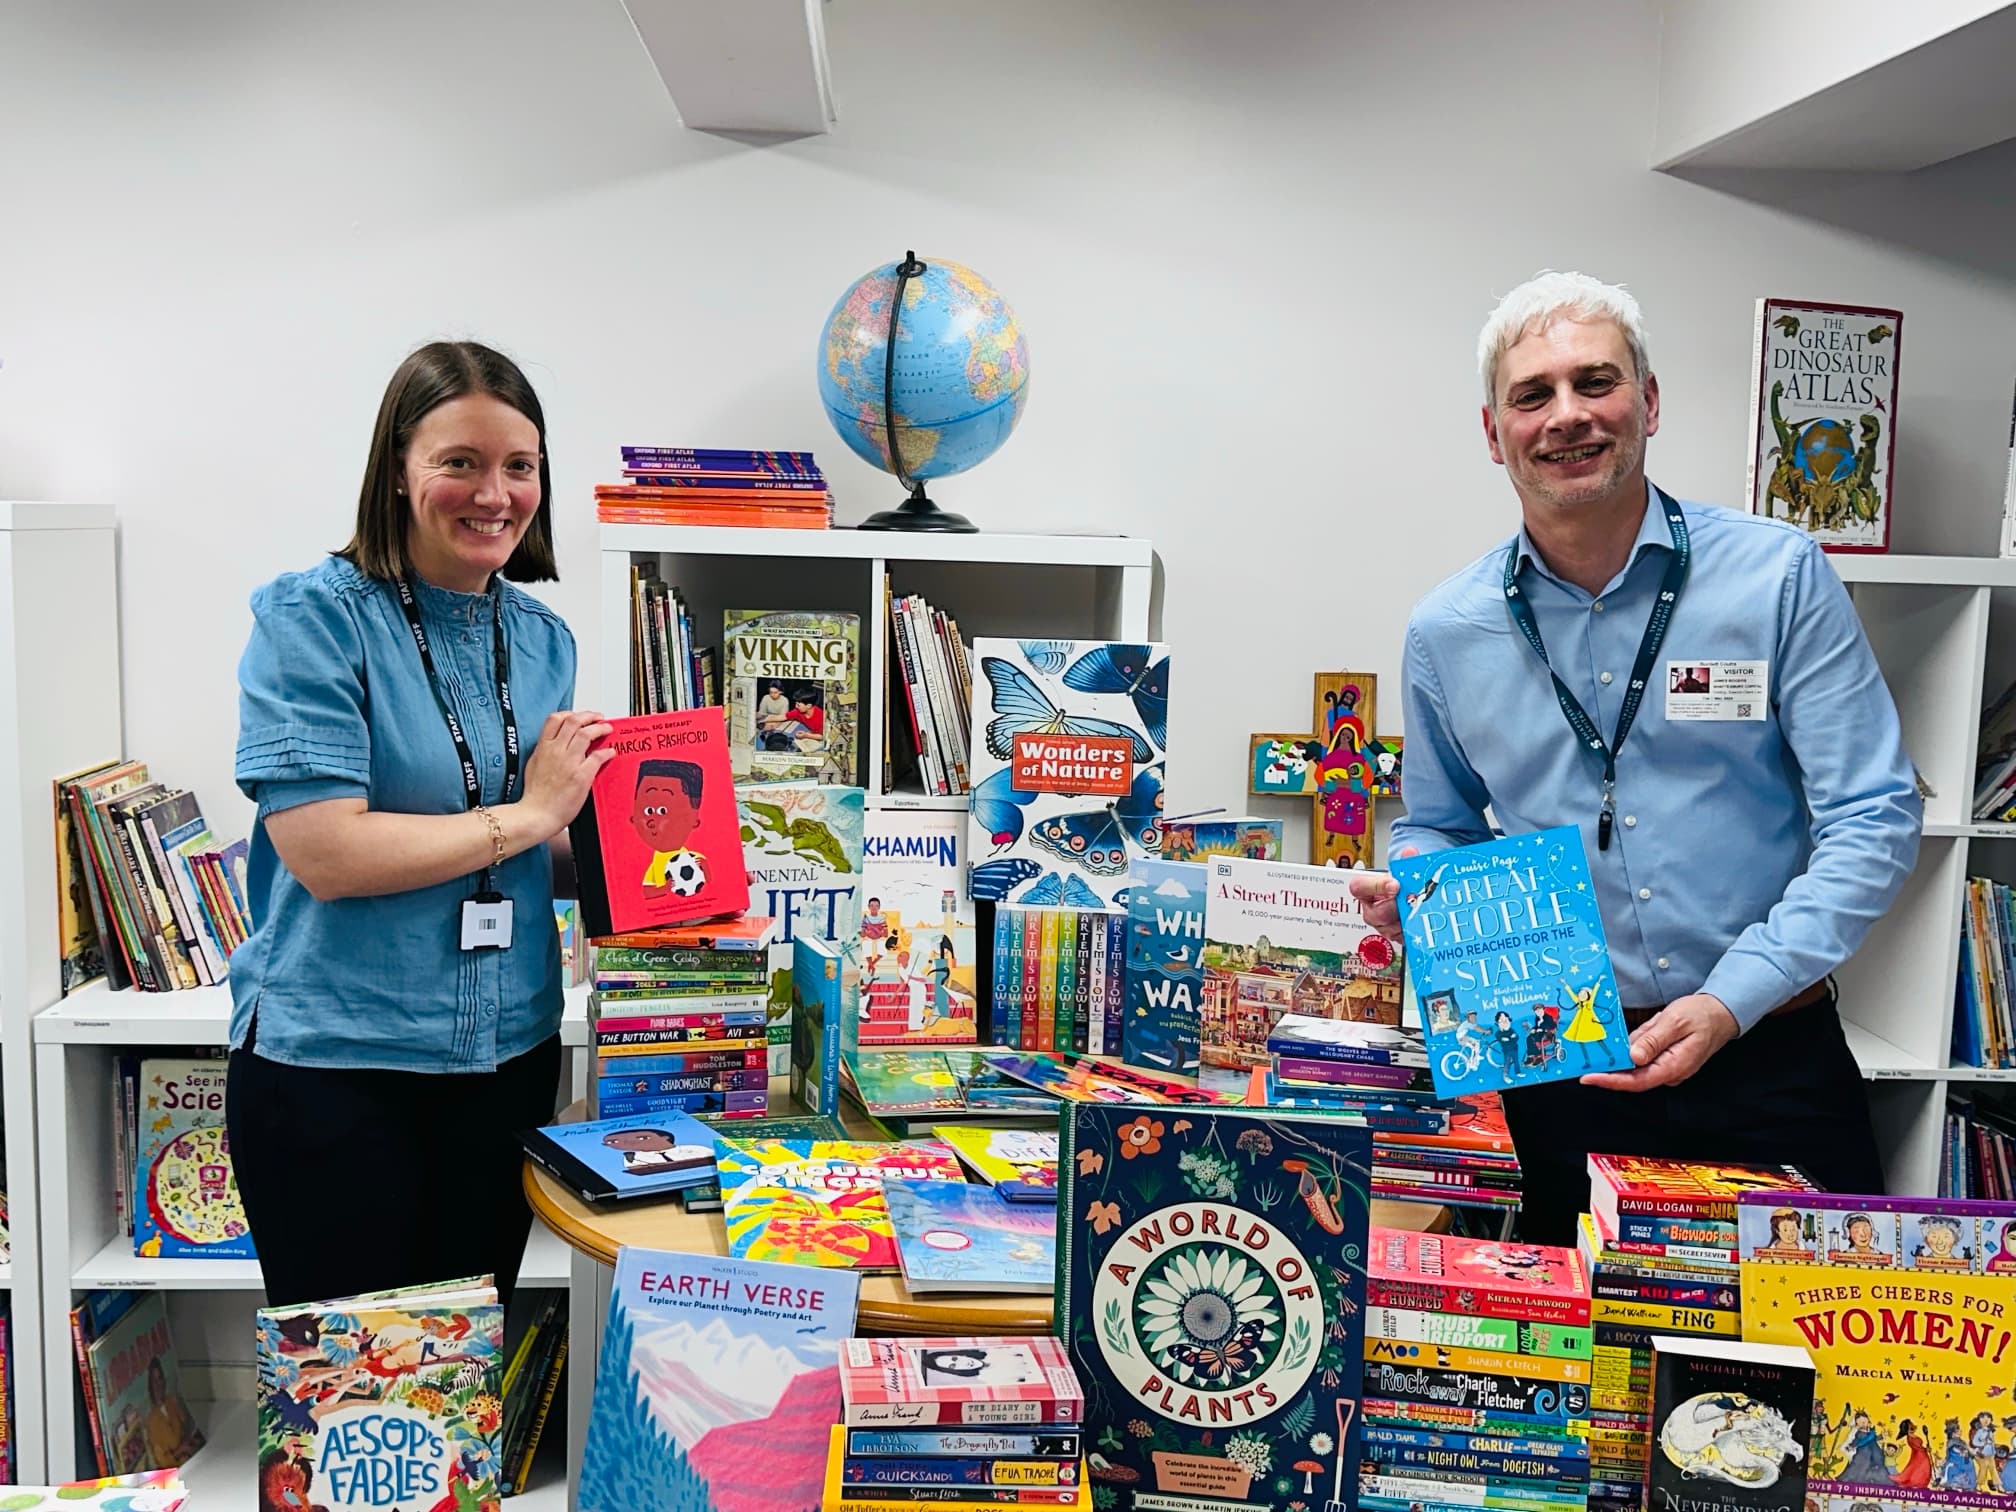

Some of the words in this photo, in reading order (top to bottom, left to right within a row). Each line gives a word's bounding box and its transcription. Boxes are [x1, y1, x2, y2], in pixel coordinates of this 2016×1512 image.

[1822, 317, 1845, 330] THE
[1798, 328, 1866, 352] GREAT
[1774, 348, 1888, 377] DINOSAUR
[1783, 373, 1875, 405] ATLAS
[412, 623, 427, 652] STAFF
[738, 637, 843, 665] VIKING
[762, 663, 820, 679] STREET
[501, 682, 511, 711] STAFF
[506, 726, 518, 756] STAFF
[609, 736, 652, 756] MARCUS
[657, 731, 709, 751] RASHFORD
[1019, 741, 1126, 763] Wonders
[463, 761, 477, 791] STAFF
[1021, 764, 1040, 777] of
[1041, 760, 1123, 780] Nature
[863, 835, 957, 867] KHAMUN
[1454, 860, 1490, 876] Louise
[1491, 855, 1519, 870] Page
[1440, 864, 1544, 908] GREAT
[1217, 883, 1229, 899] A
[1232, 886, 1277, 905] Street
[1280, 889, 1349, 917] Through
[1283, 915, 1305, 925] journey
[1306, 915, 1322, 927] along
[1323, 918, 1332, 926] the
[1351, 922, 1368, 930] street
[1421, 888, 1578, 950] PEOPLE
[1026, 913, 1039, 974] ARTEMIS
[1061, 913, 1073, 974] ARTEMIS
[1078, 915, 1090, 975] ARTEMIS
[1093, 915, 1106, 976] ARTEMIS
[1111, 916, 1122, 978] ARTEMIS
[1434, 948, 1464, 962] WHO
[1466, 936, 1521, 957] REACHED
[1524, 932, 1549, 946] FOR
[1551, 926, 1575, 940] THE
[642, 951, 670, 967] Green
[1455, 946, 1564, 992] STARS
[1024, 977, 1037, 1011] FOWL
[1059, 977, 1072, 1011] FOWL
[1075, 978, 1089, 1013] FOWL
[1091, 980, 1104, 1013] FOWL
[1108, 982, 1121, 1016] FOWL
[1482, 997, 1500, 1011] Kat
[1502, 991, 1550, 1008] Williams
[601, 1033, 620, 1044] THE
[622, 1032, 657, 1043] BUTTON
[660, 1030, 680, 1040] WAR
[727, 1029, 742, 1039] AVI
[660, 1076, 713, 1092] SHADOWGHAST
[741, 1163, 948, 1181] COLOURFUL
[1622, 1200, 1653, 1211] DAVID
[1656, 1202, 1693, 1213] LOGAN
[1696, 1204, 1710, 1214] THE
[1631, 1231, 1651, 1239] PINES
[1108, 1263, 1137, 1287] A
[1128, 1208, 1270, 1253] WORLD
[1275, 1256, 1315, 1302] OF
[640, 1271, 730, 1300] EARTH
[743, 1283, 825, 1311] VERSE
[1389, 1293, 1443, 1310] HUNTED
[1487, 1293, 1523, 1305] KIERAN
[1524, 1295, 1572, 1309] LARWOOD
[1597, 1286, 1638, 1297] SMARTEST
[1795, 1285, 1862, 1305] THREE
[1871, 1285, 1953, 1305] CHEERS
[1962, 1295, 2005, 1318] FOR
[648, 1296, 677, 1308] Explore
[693, 1301, 719, 1311] Planet
[721, 1303, 752, 1315] through
[754, 1307, 781, 1320] Poetry
[782, 1310, 797, 1320] and
[799, 1313, 812, 1321] Art
[1431, 1314, 1483, 1332] RUBY
[1671, 1309, 1716, 1330] FING
[1430, 1330, 1507, 1349] REDFORT
[1793, 1307, 2012, 1364] WOMEN!
[1689, 1361, 1745, 1377] MICHAEL
[1750, 1367, 1785, 1381] ENDE
[1836, 1364, 1893, 1380] MARCIA
[1900, 1368, 1973, 1386] WILLIAMS
[1456, 1374, 1498, 1393] Charlie
[968, 1404, 986, 1412] THE
[990, 1404, 1021, 1412] DIARY
[1025, 1403, 1037, 1411] OF
[1140, 1374, 1278, 1423] PLANTS
[1477, 1391, 1526, 1410] Fletcher
[968, 1414, 974, 1422] A
[976, 1414, 1002, 1422] YOUNG
[1008, 1413, 1037, 1422] GIRL
[1416, 1404, 1448, 1414] FAMOUS
[1449, 1407, 1468, 1416] FIVE
[880, 1434, 901, 1444] EVA
[1367, 1431, 1393, 1440] ROALD
[1395, 1433, 1417, 1443] DAHL
[1469, 1437, 1514, 1454] CHARLIE
[861, 1443, 919, 1454] IBBOTSON
[1165, 1460, 1197, 1469] Celebrate
[1210, 1464, 1242, 1473] incredible
[1428, 1451, 1459, 1466] NIGHT
[1460, 1453, 1481, 1469] OWL
[1502, 1458, 1545, 1475] DOGFISH
[329, 1454, 440, 1506] FABLES
[876, 1471, 953, 1482] QUICKSANDS
[1169, 1470, 1188, 1478] world
[1208, 1483, 1226, 1491] guide
[1807, 1482, 1832, 1491] OVER
[1837, 1483, 1850, 1493] 70
[1855, 1486, 1925, 1500] INSPIRATIONAL
[1930, 1493, 1949, 1502] AND
[1954, 1494, 1999, 1508] AMAZING
[1141, 1498, 1165, 1506] JAMES
[1166, 1500, 1193, 1510] BROWN
[1202, 1504, 1232, 1512] MARTIN
[1721, 1495, 1736, 1503] THE
